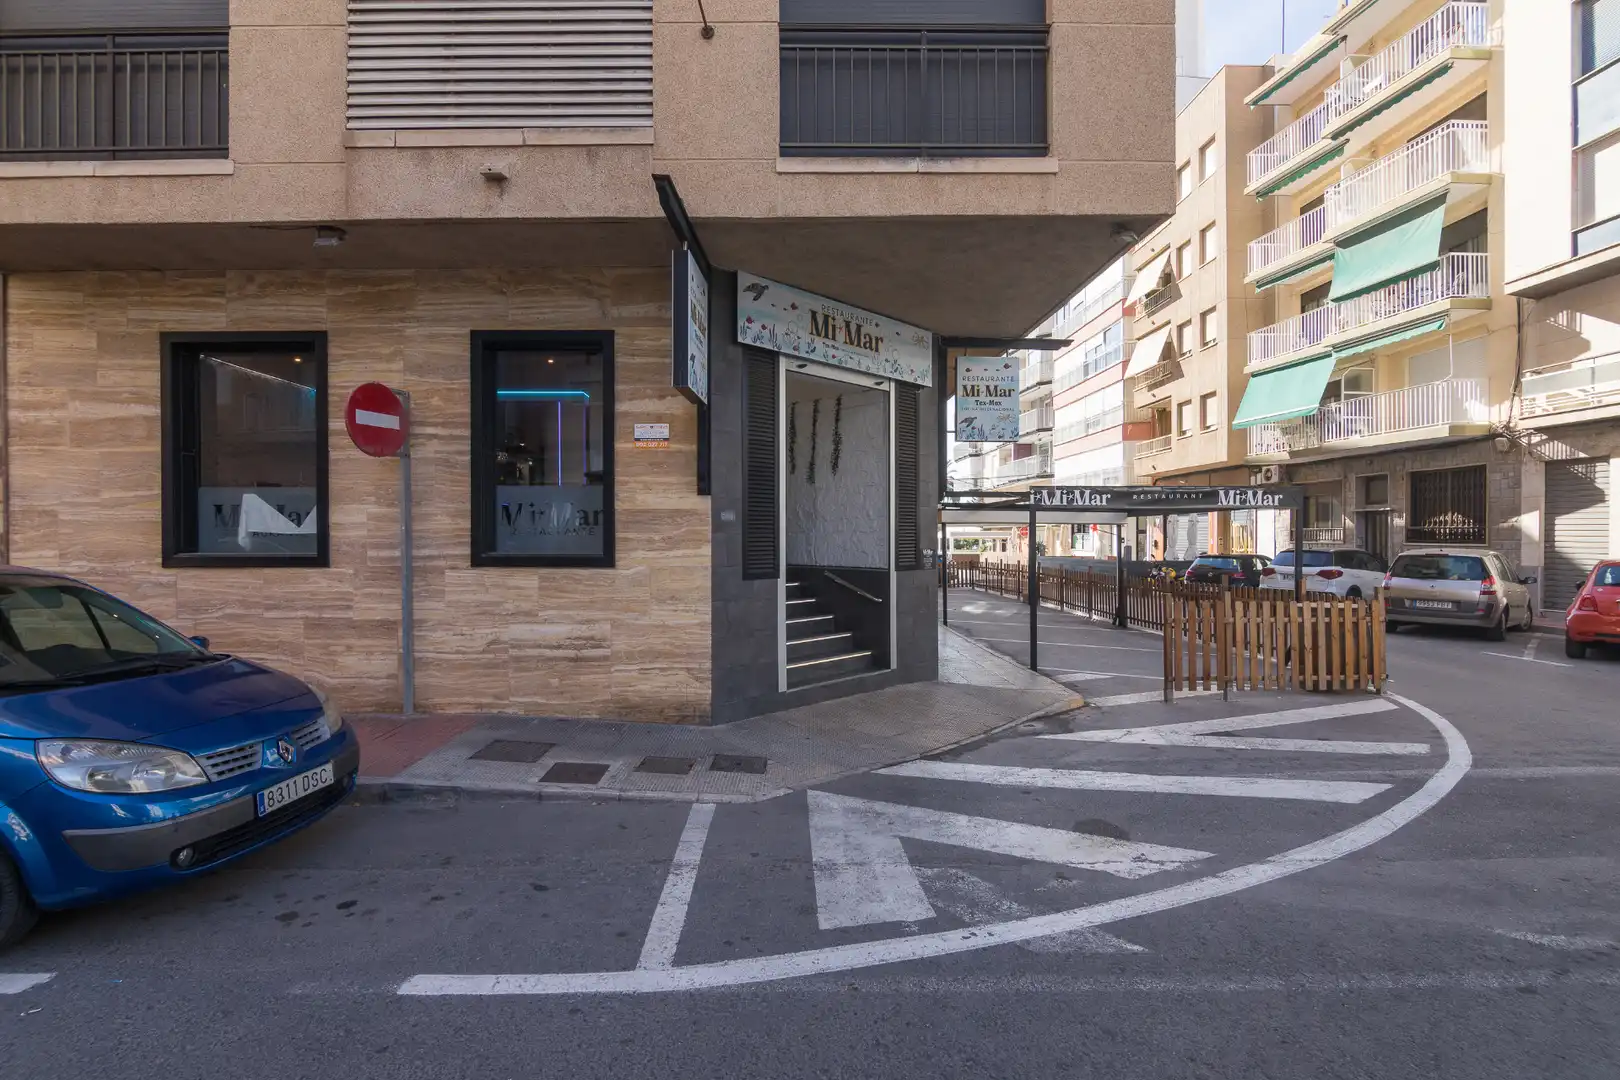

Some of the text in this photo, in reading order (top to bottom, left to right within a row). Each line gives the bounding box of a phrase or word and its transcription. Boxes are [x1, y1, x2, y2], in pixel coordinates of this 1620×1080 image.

[821, 304, 873, 327] RESTAURANTE
[809, 309, 884, 353] Mi Mar
[962, 385, 1015, 397] Mi Mar
[1073, 489, 1111, 506] Mar
[1217, 489, 1283, 506] Mi Mar
[267, 769, 328, 807] 8311 DSC
